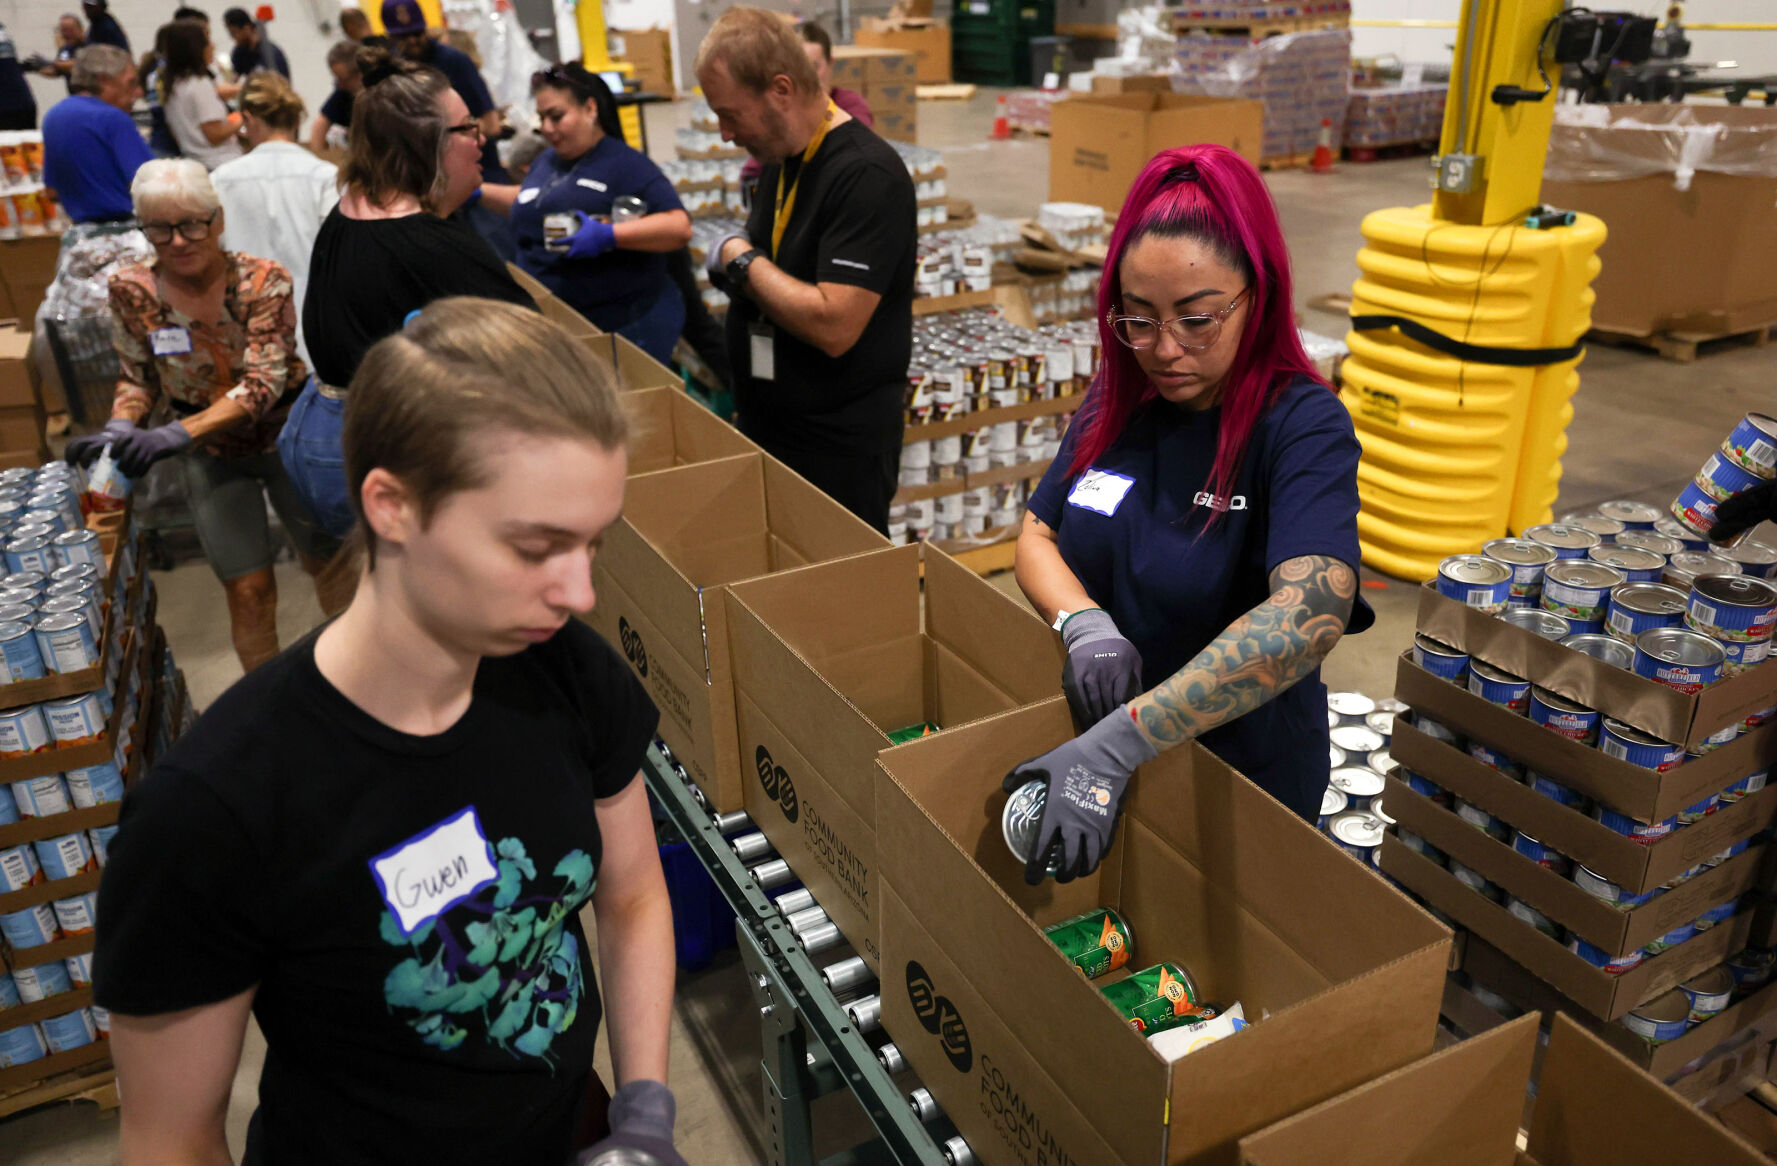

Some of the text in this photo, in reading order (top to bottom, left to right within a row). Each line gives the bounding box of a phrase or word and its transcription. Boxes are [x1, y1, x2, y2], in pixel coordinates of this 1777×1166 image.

[393, 854, 469, 910] Gwen
[802, 800, 868, 884] COMMUNITY
[804, 819, 869, 908] FOOD BANK
[981, 1054, 1078, 1166] COMMUNI
[981, 1075, 1032, 1150] FOOD
